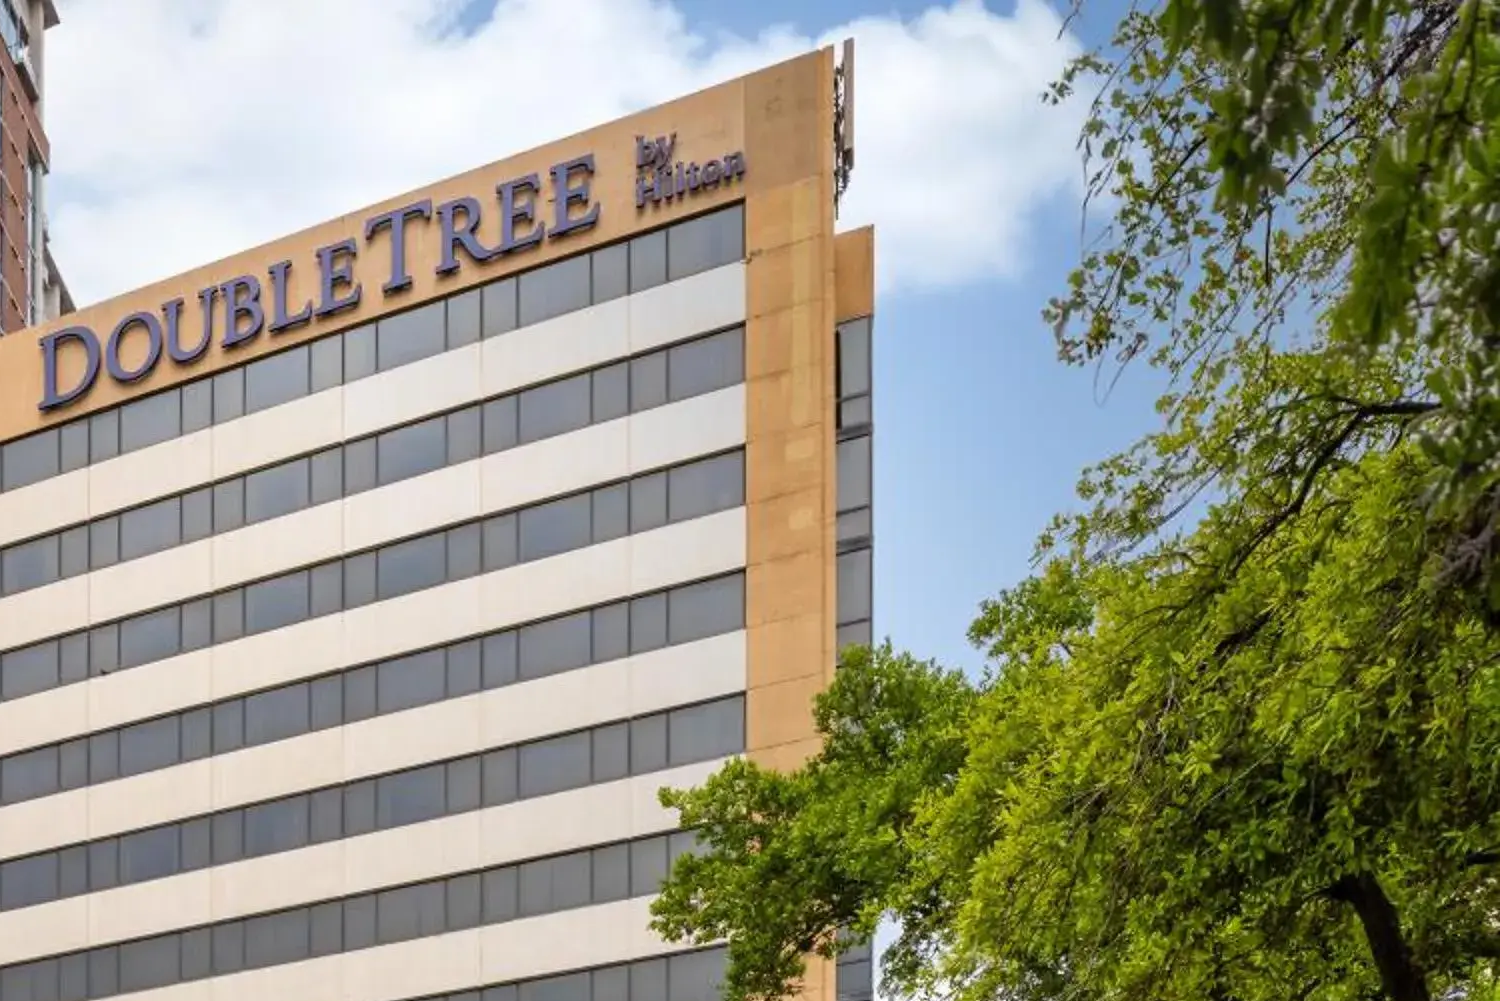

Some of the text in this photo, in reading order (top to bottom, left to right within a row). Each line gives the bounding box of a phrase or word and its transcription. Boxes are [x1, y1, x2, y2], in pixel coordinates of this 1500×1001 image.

[635, 131, 677, 170] by
[635, 151, 746, 208] Hilton
[37, 153, 601, 412] DOUBLETREE
